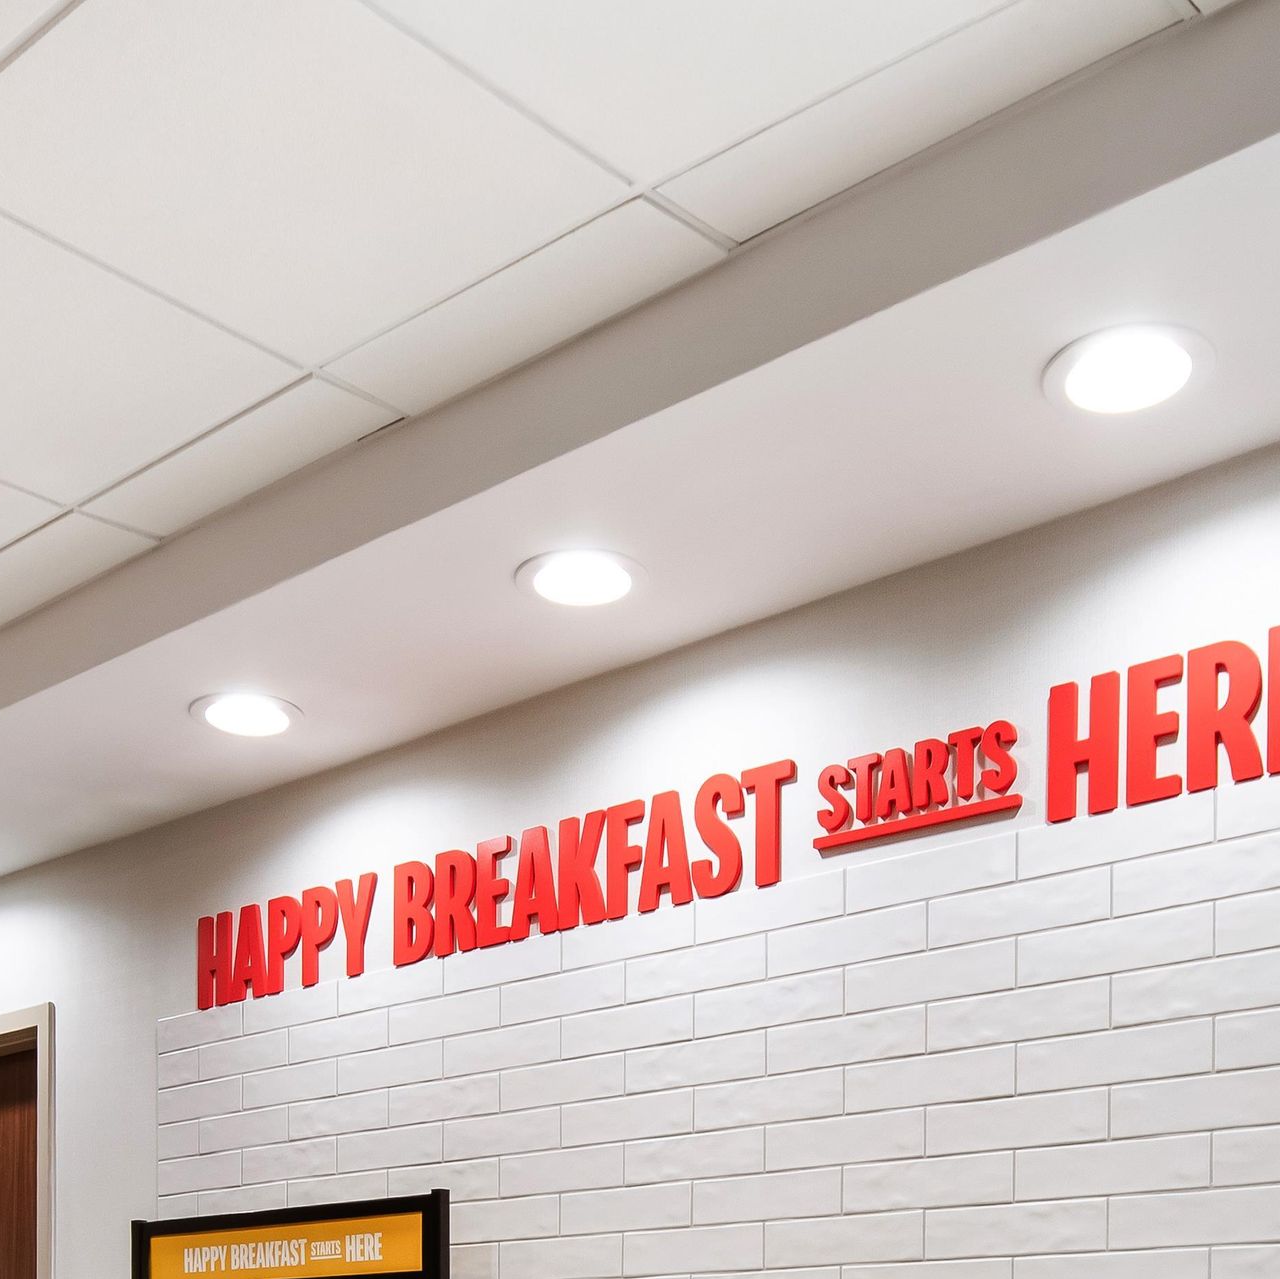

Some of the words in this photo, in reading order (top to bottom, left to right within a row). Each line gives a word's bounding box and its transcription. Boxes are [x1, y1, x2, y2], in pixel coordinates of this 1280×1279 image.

[197, 871, 378, 1011] HAPPY
[393, 759, 798, 967] BREAKFAST
[817, 720, 1020, 834] STARTS
[183, 1244, 228, 1273] HAPPY
[230, 1238, 308, 1271] BREAKFAST
[310, 1239, 341, 1256] STARTS
[345, 1232, 384, 1262] HERE
